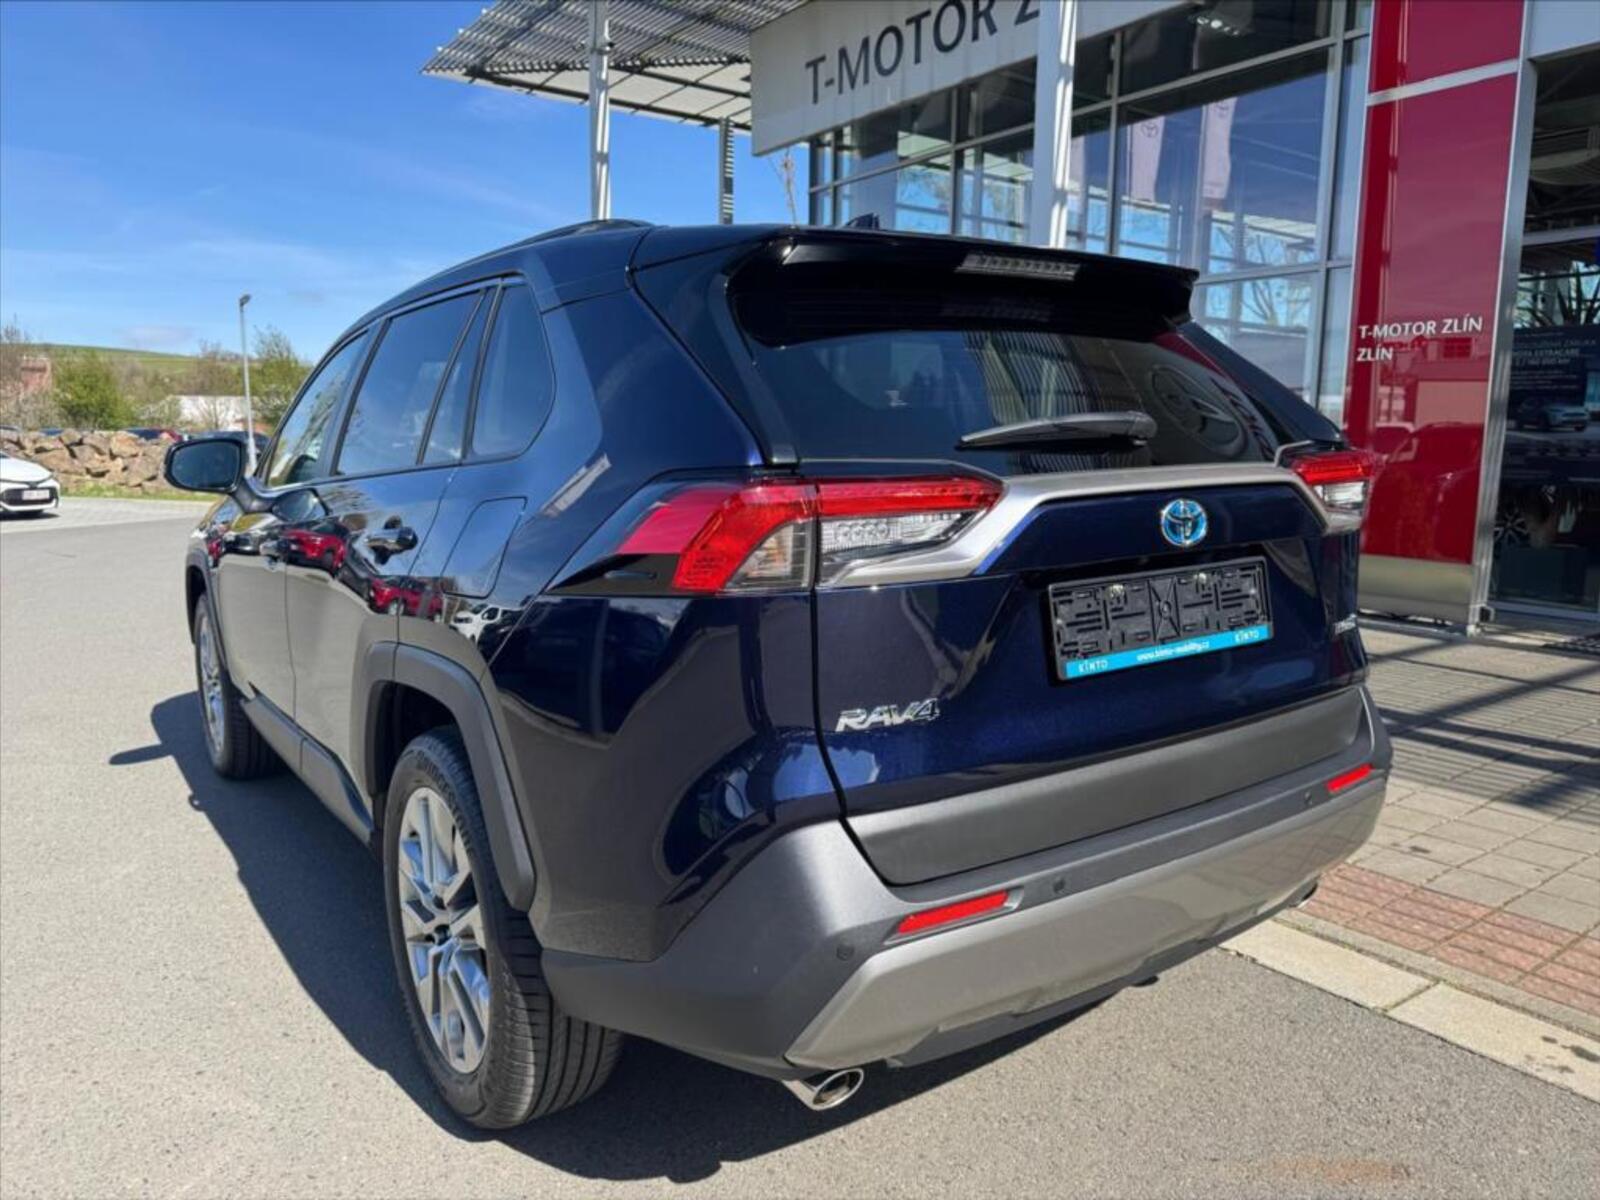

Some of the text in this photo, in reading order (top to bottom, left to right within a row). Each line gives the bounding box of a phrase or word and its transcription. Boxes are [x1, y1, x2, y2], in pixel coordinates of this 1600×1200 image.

[804, 0, 998, 105] T-MOTOR
[1358, 313, 1483, 339] T-MOTOR ZLÍN
[1356, 343, 1394, 362] ZLÍN
[835, 697, 941, 733] RAV4
